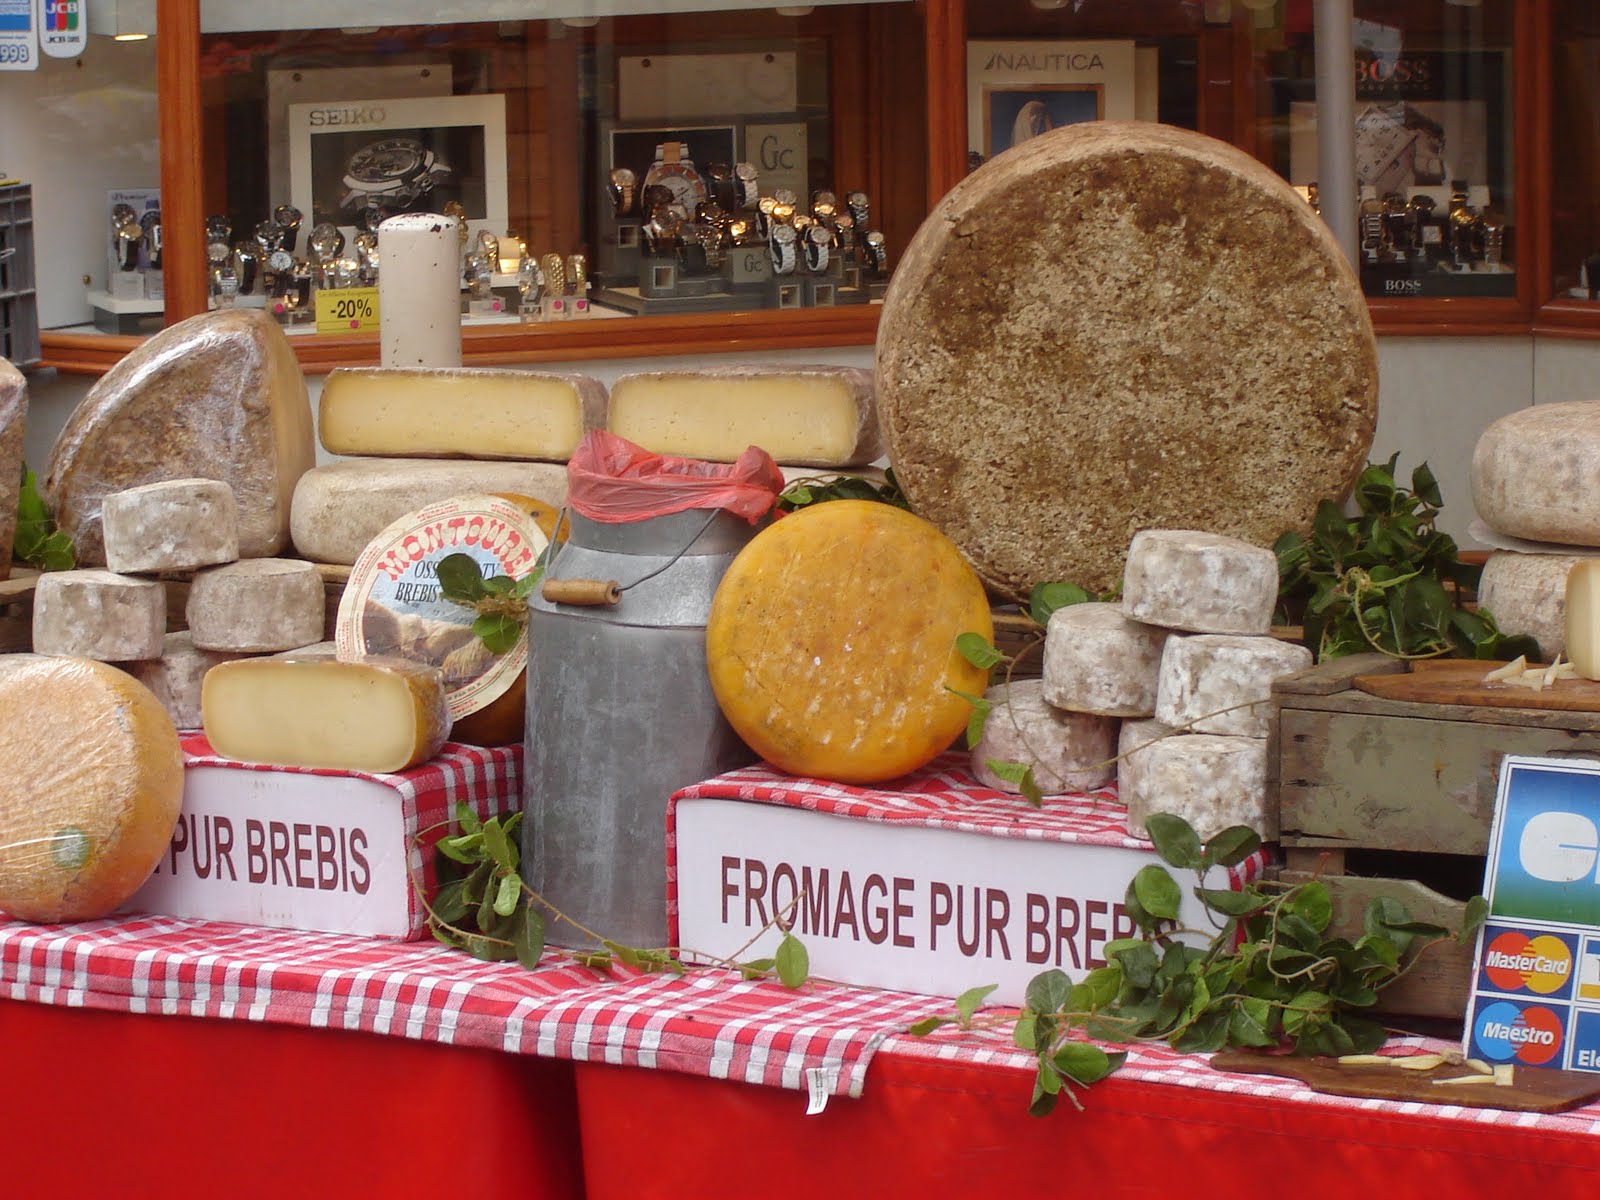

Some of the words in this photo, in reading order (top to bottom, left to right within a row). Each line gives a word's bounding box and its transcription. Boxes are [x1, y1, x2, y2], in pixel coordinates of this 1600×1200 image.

[46, 3, 78, 14] JCB
[996, 54, 1104, 70] NAUTICA
[1355, 59, 1430, 82] BOSS
[309, 108, 386, 126] SEIKO
[760, 135, 794, 171] Gc
[1385, 279, 1422, 291] BOSS
[330, 298, 372, 318] -20%
[394, 582, 441, 604] BREBIS
[171, 813, 238, 881] PUR
[246, 818, 371, 896] BREBIS
[721, 855, 915, 948] FROMAGE
[930, 881, 1012, 961] PUR
[1485, 950, 1570, 975] MasterCard
[1482, 1021, 1555, 1046] Maestro
